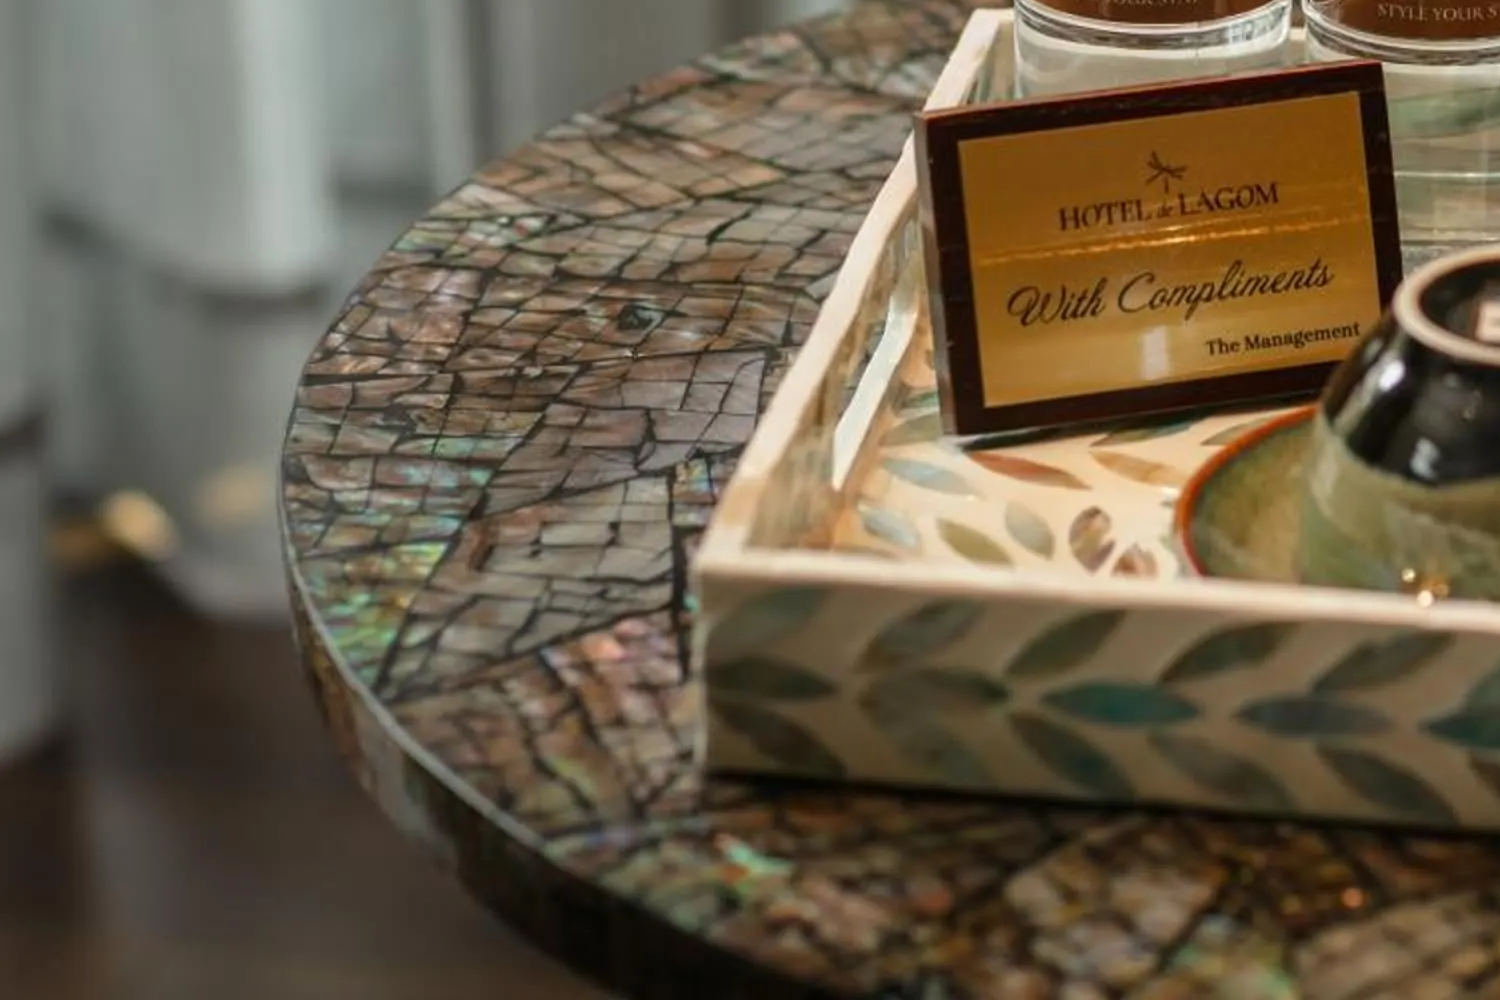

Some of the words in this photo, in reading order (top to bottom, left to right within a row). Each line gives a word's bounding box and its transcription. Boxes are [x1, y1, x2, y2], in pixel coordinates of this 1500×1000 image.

[1377, 2, 1428, 22] STYLE
[1433, 4, 1482, 22] YOUR
[1058, 199, 1153, 232] HOTEL
[1156, 199, 1175, 220] de
[1178, 182, 1280, 216] LAGOM
[1007, 278, 1107, 328] With
[1117, 258, 1335, 321] Compliments
[1205, 337, 1240, 358] The
[1244, 321, 1361, 353] Management
